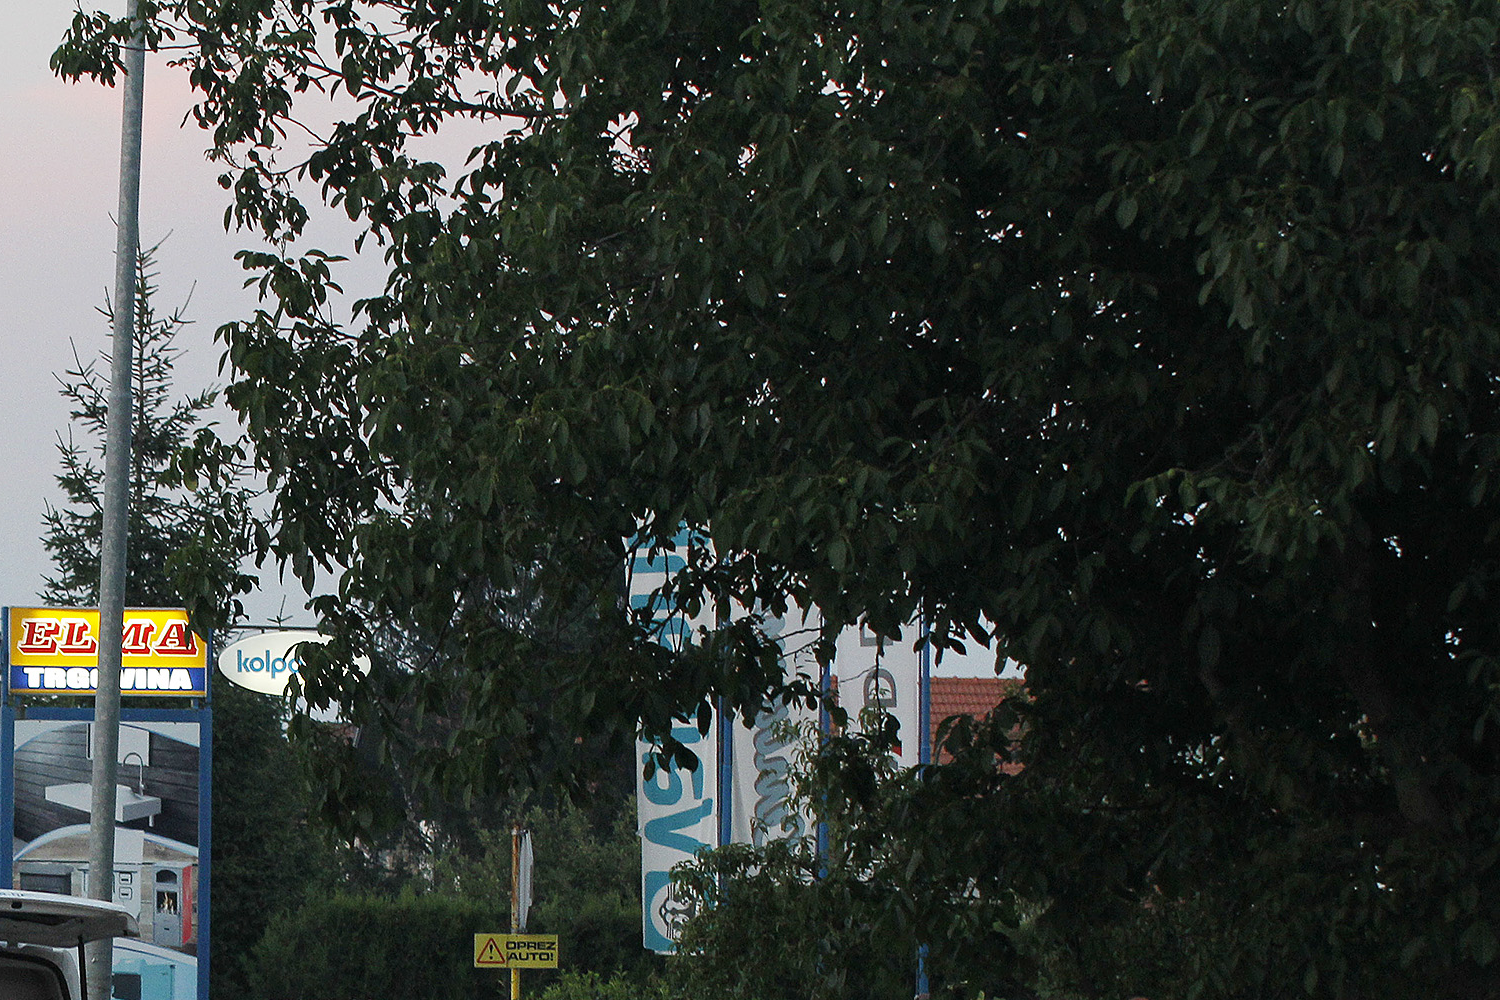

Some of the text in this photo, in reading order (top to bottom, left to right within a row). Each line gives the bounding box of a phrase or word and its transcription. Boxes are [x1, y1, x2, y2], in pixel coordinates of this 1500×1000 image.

[17, 618, 199, 656] ELMA
[506, 941, 556, 950] OPREZ
[508, 952, 553, 961] AUTO!
